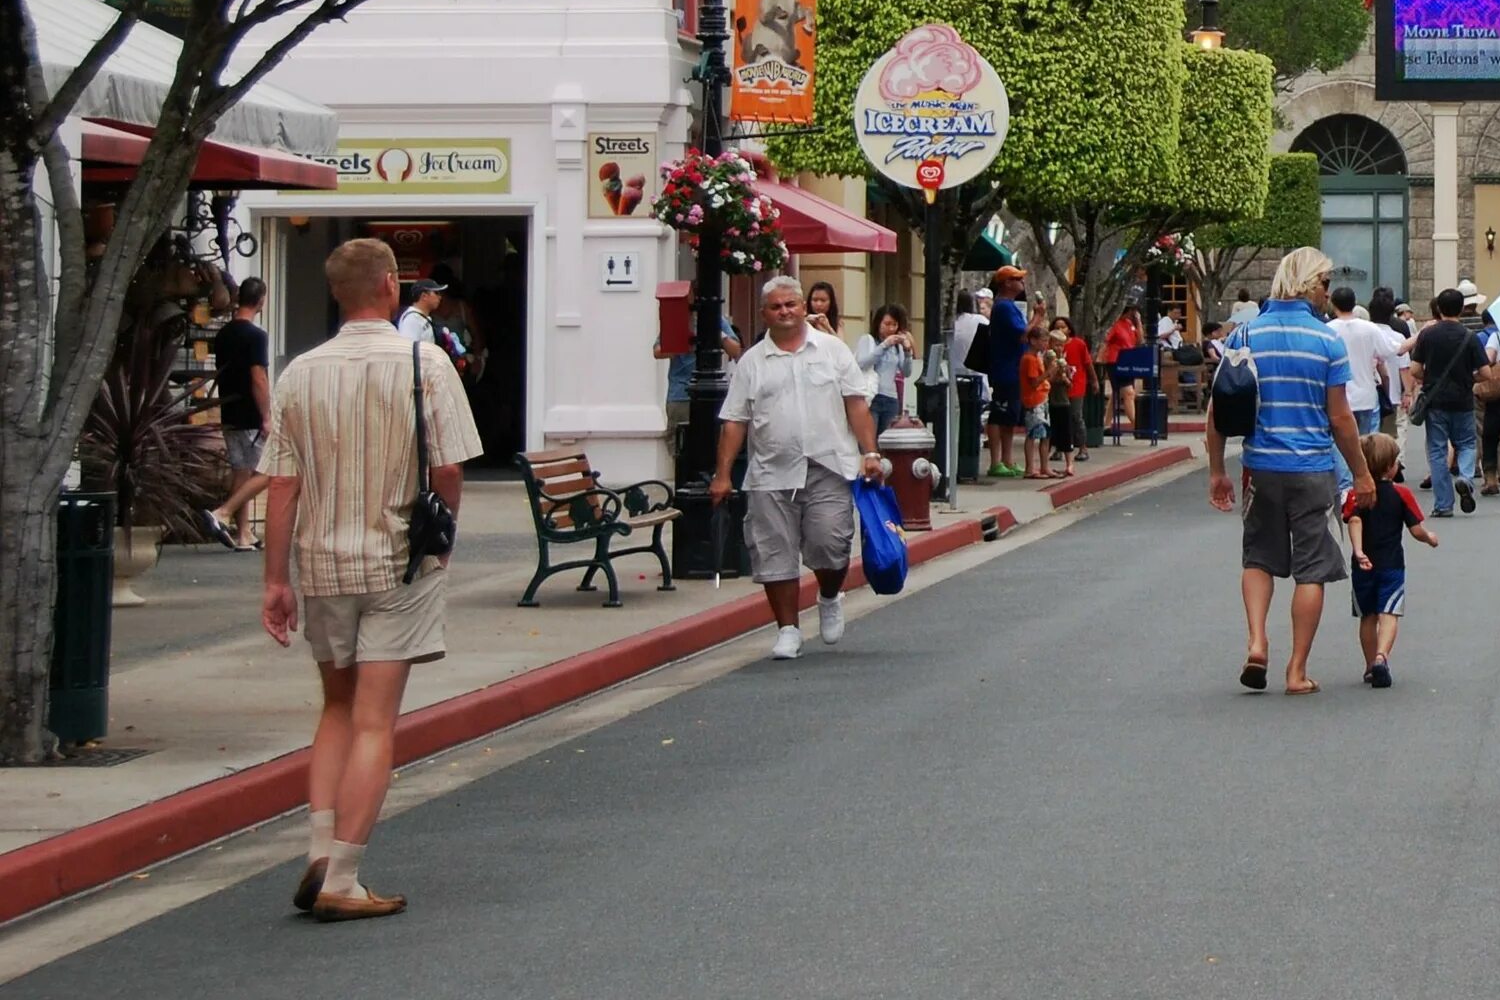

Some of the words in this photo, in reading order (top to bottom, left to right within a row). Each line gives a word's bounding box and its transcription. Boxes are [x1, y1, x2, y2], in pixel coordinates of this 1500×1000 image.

[865, 109, 996, 137] ICECREAM
[595, 137, 650, 155] Streets
[885, 135, 985, 165] Parlour
